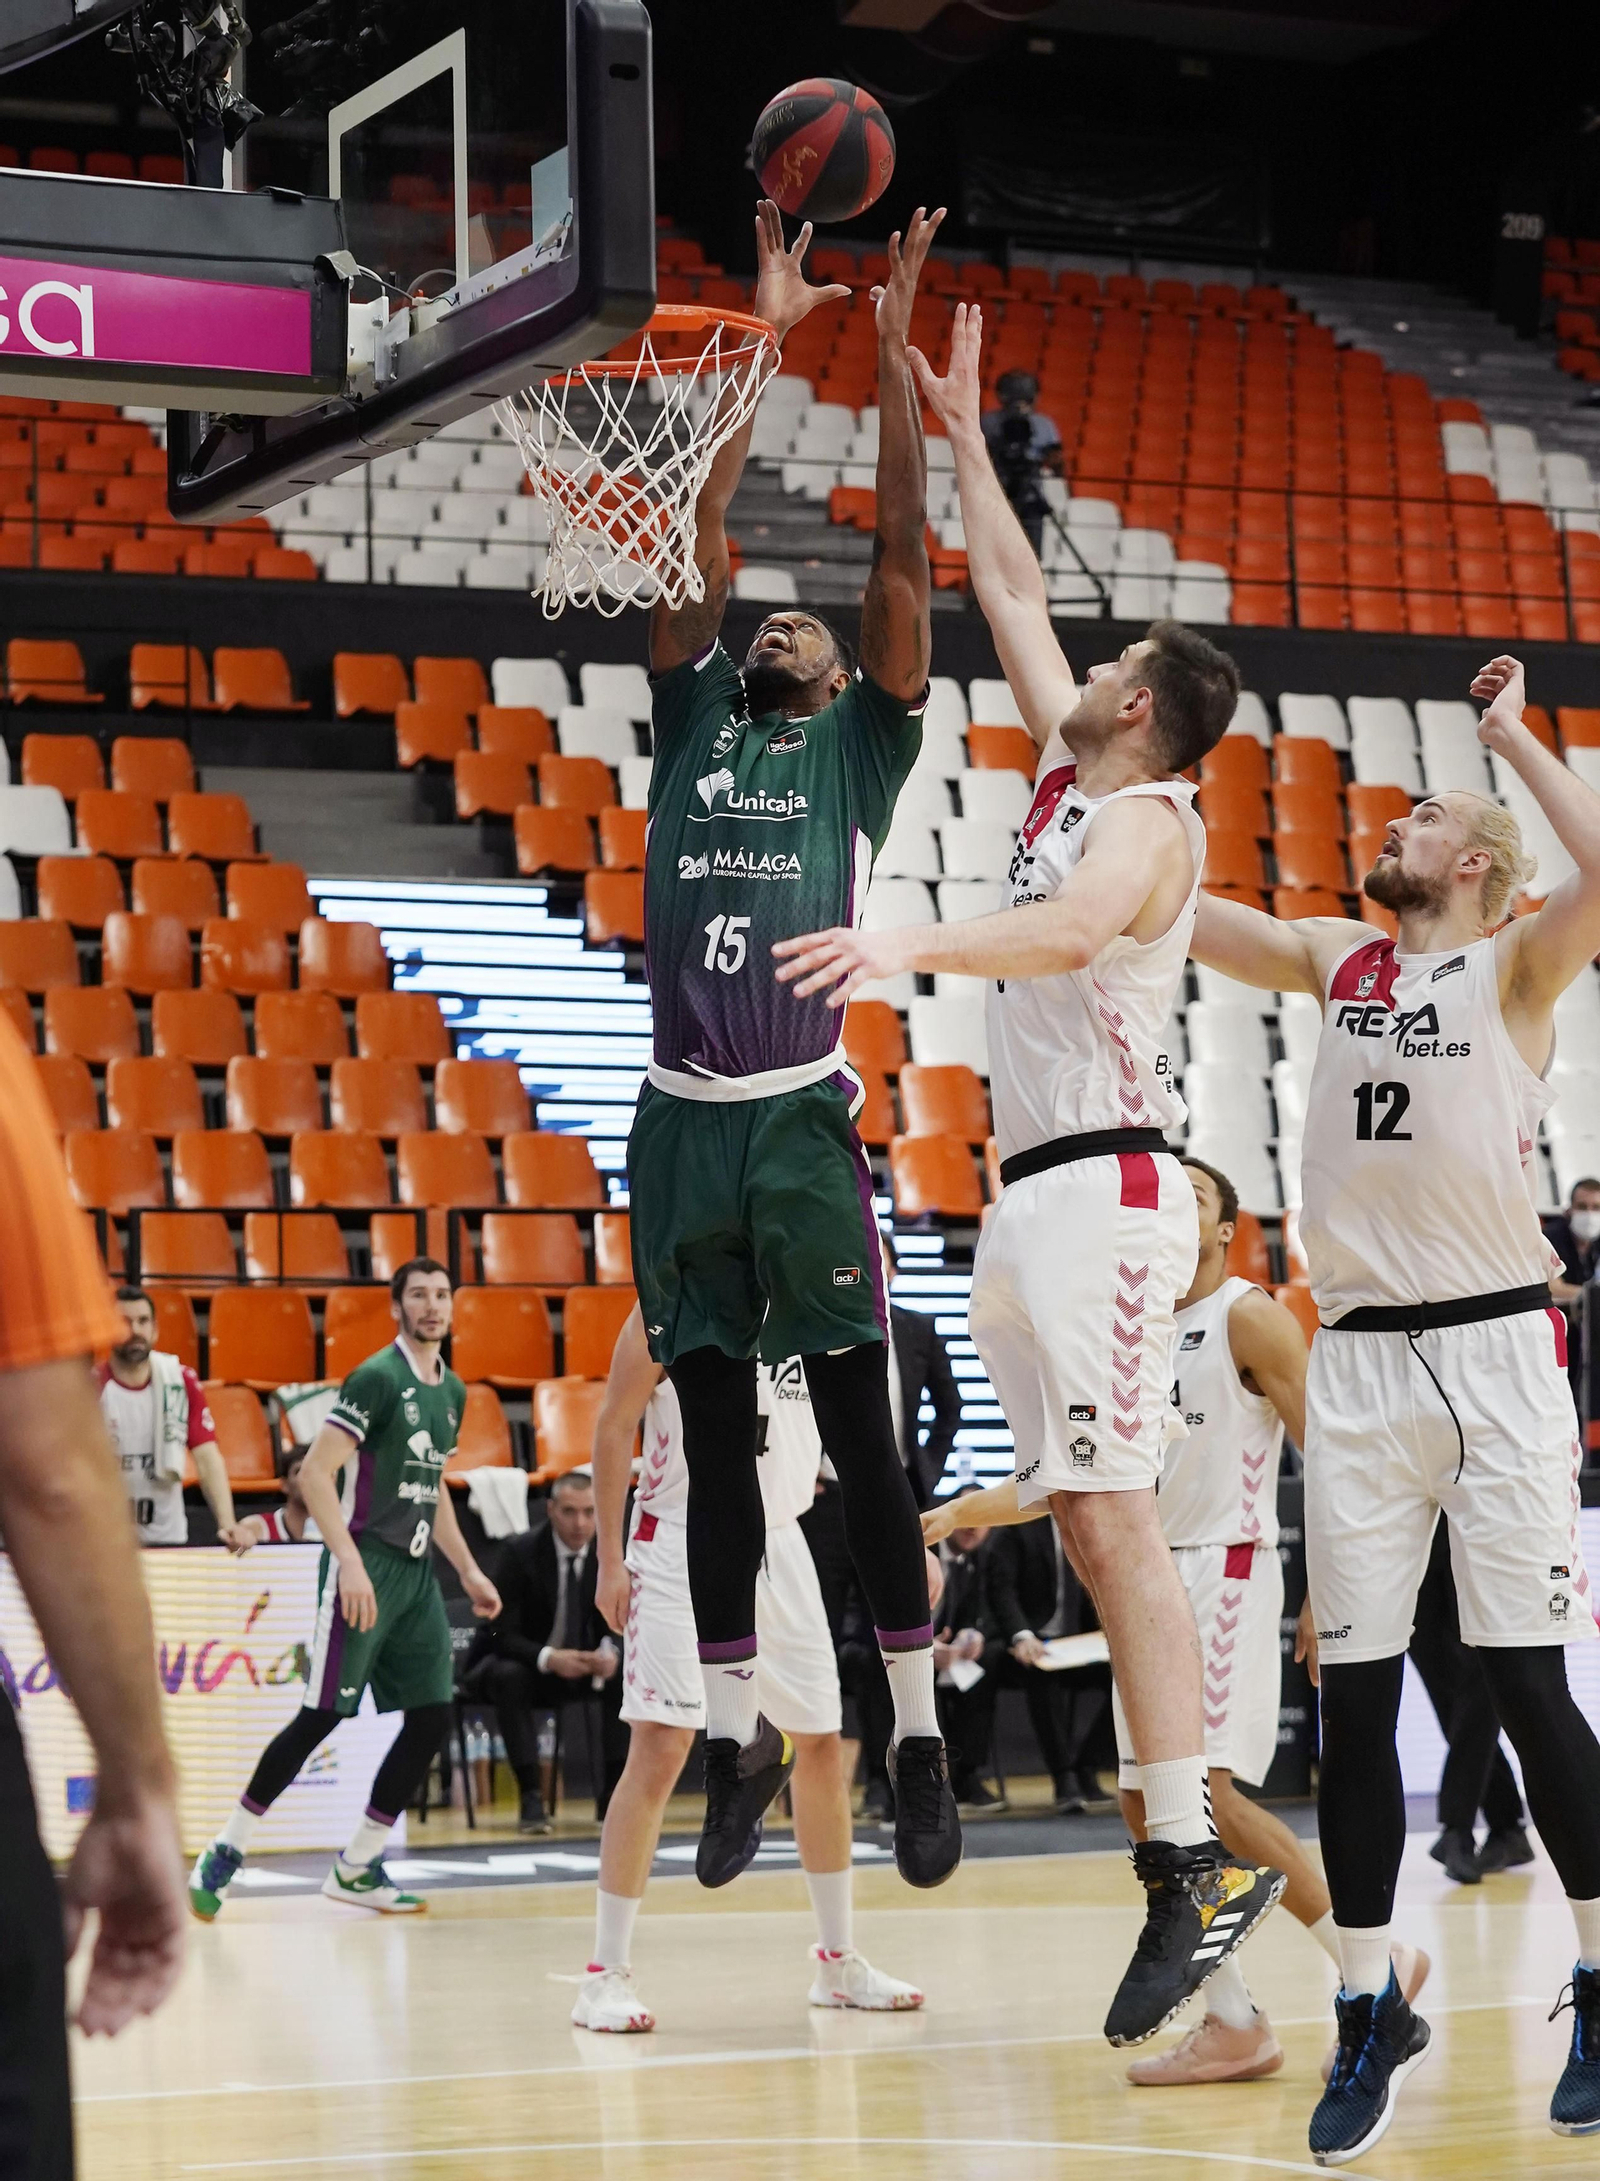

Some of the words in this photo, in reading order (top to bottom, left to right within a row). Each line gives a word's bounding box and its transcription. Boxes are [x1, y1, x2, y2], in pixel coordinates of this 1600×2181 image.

[0, 280, 95, 356] a
[727, 789, 808, 816] Unicaja
[713, 847, 801, 872] MÁLAGA
[713, 869, 747, 878] EUROPEAN
[748, 871, 772, 880] CAPITAL
[781, 872, 801, 880] SPORT
[704, 914, 751, 974] 15
[1403, 1039, 1471, 1058] bet.es
[1353, 1081, 1413, 1140] 12
[836, 1274, 854, 1283] acb
[1070, 1411, 1090, 1420] acb
[409, 1519, 430, 1558] 8
